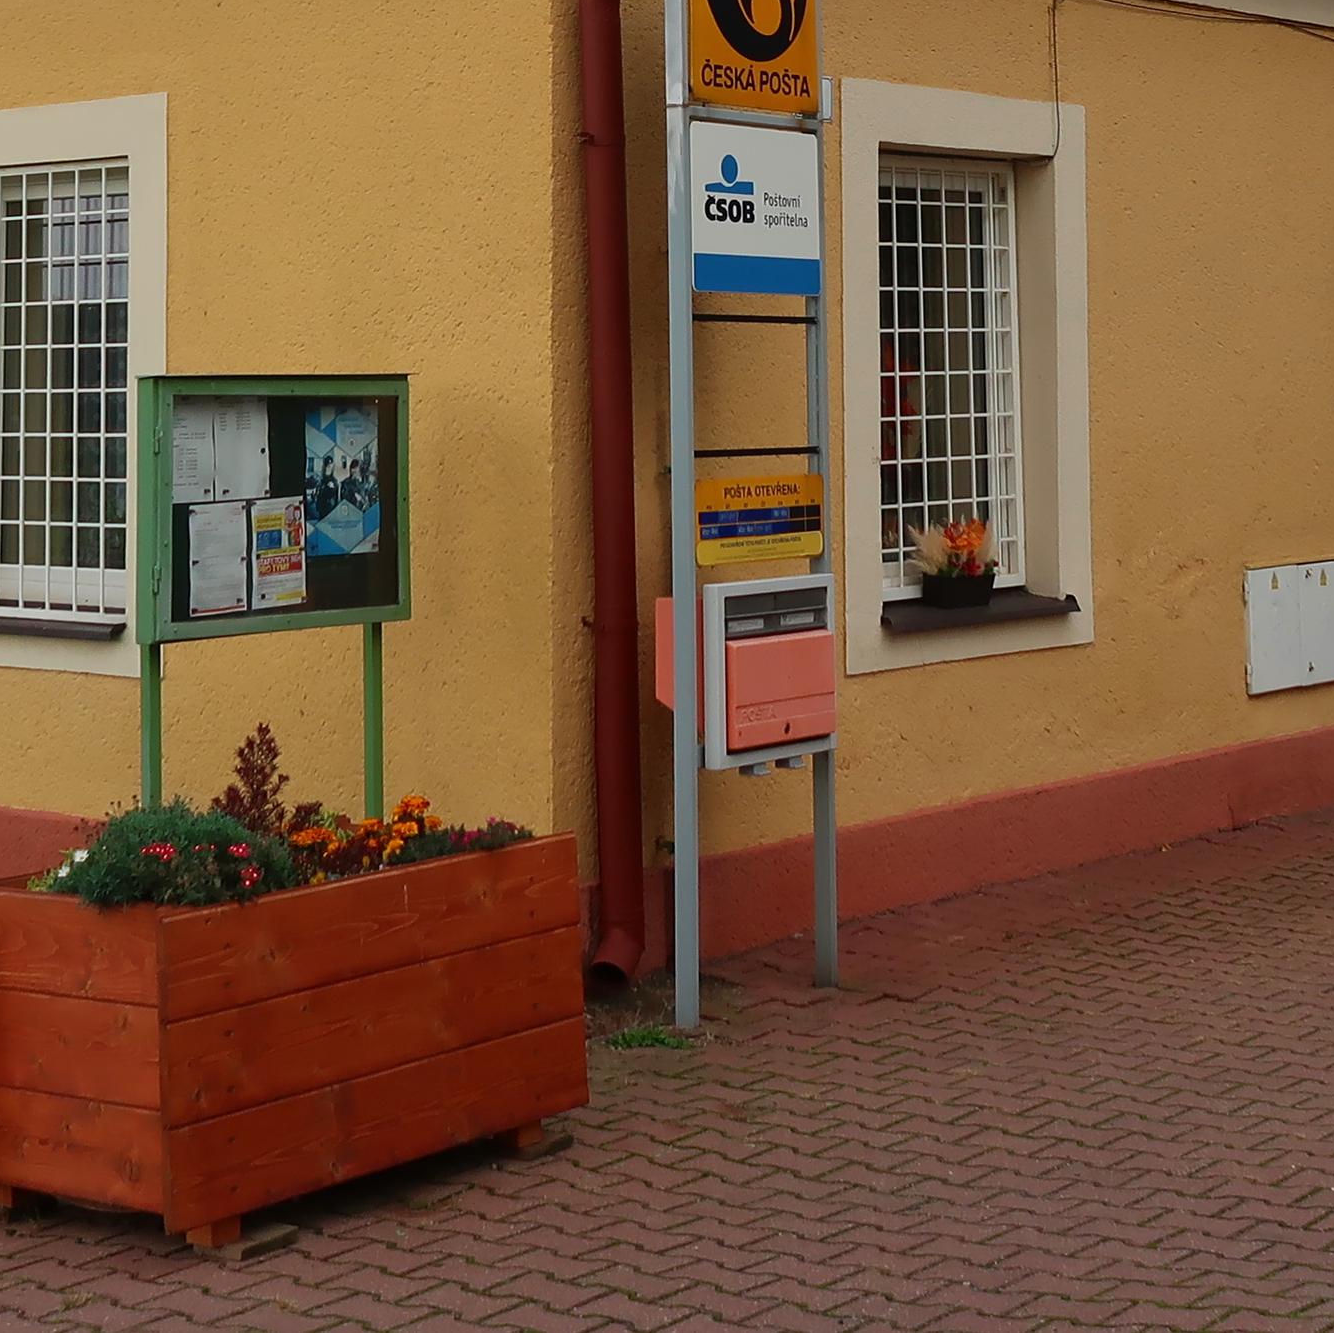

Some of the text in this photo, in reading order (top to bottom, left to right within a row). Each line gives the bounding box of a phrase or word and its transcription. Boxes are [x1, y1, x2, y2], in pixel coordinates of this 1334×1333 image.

[701, 59, 811, 97] ČESKÁ POŠTA
[763, 192, 801, 208] Poštovní
[704, 195, 755, 223] ČSOB
[763, 213, 809, 228] spořitelna
[723, 484, 753, 499] POŠTA
